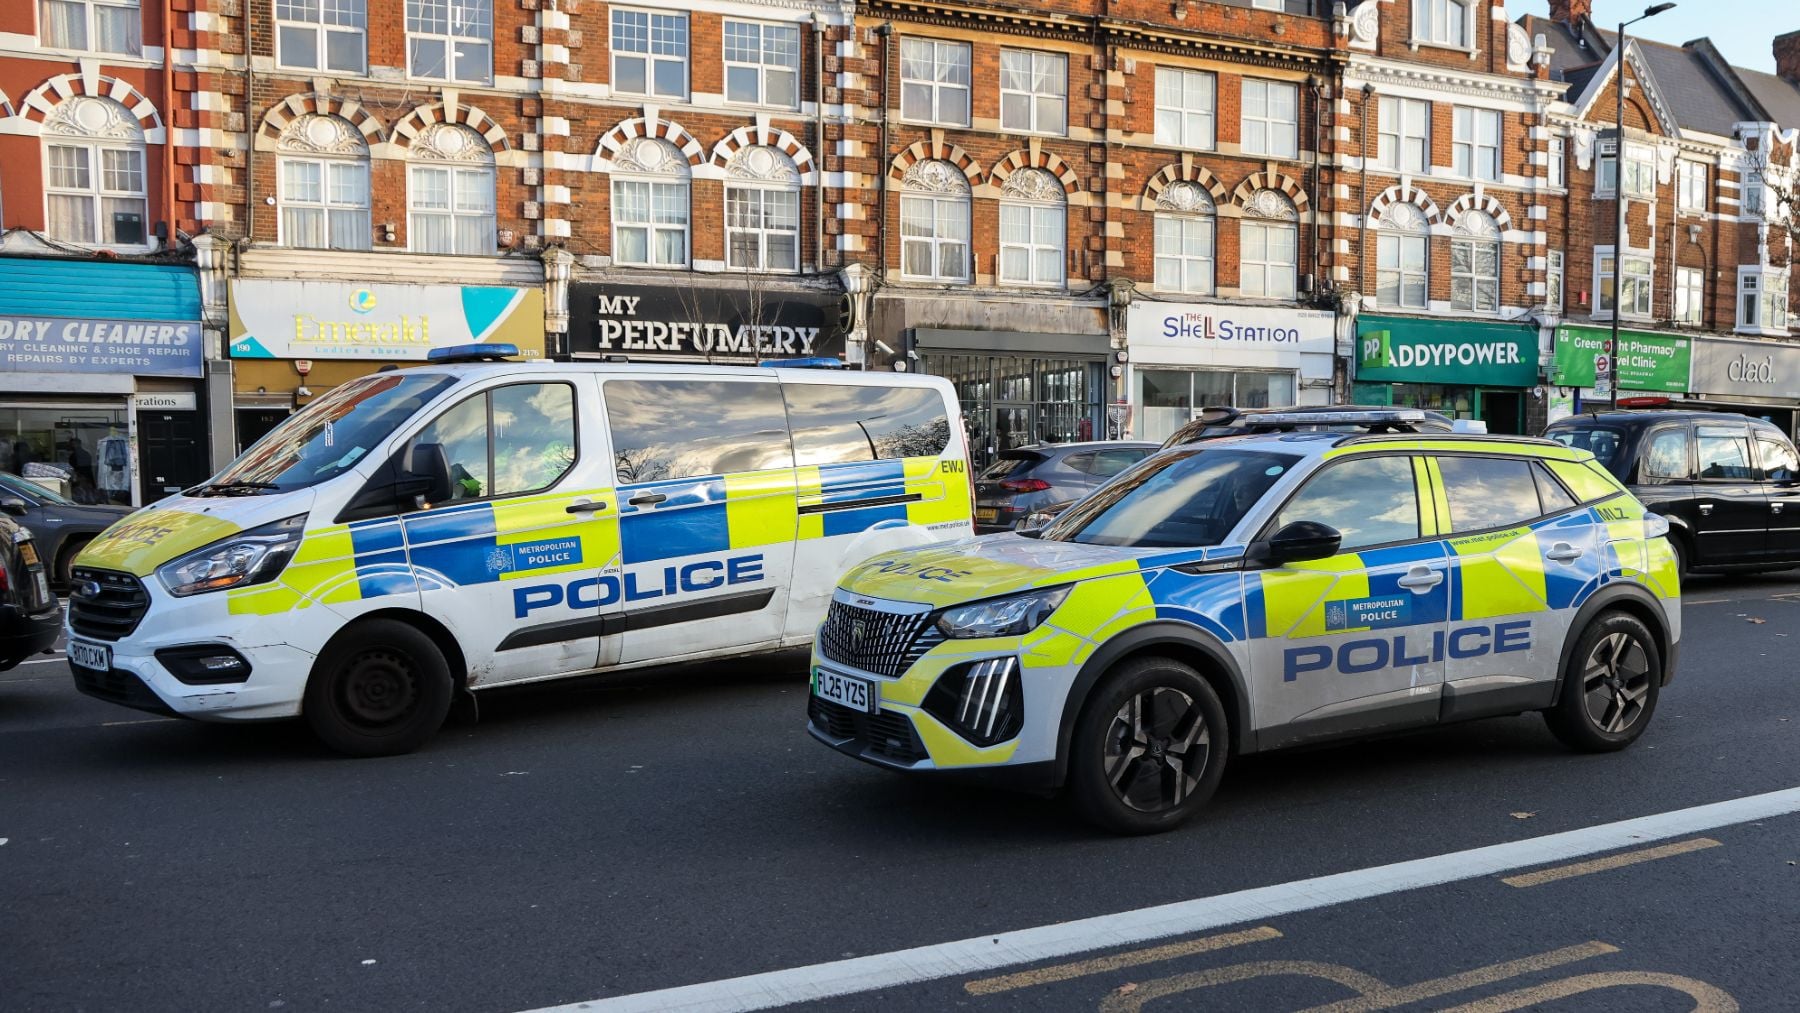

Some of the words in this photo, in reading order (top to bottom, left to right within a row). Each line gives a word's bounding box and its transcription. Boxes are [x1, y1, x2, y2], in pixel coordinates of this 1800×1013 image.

[598, 295, 640, 316] MY
[1185, 312, 1201, 322] THE
[0, 319, 52, 342] DRY
[62, 322, 190, 346] CLEANERS
[294, 313, 430, 344] Emerald
[598, 319, 820, 355] PERFUMERY
[23, 343, 88, 353] CLEANING
[93, 345, 101, 354] &
[108, 346, 141, 355] SHOE
[147, 347, 191, 357] REPAIR
[1630, 341, 1676, 358] Pharmacy
[7, 353, 63, 363] REPAIRS
[69, 356, 86, 364] BY
[91, 356, 151, 366] EXPERTS
[1631, 356, 1657, 368] Clinic
[941, 460, 964, 473] EWJ
[1595, 507, 1630, 522] MLZ
[518, 540, 577, 555] METROPOLITAN
[528, 552, 570, 565] POLICE
[512, 553, 765, 619] POLICE
[1352, 599, 1404, 611] METROPOLITAN
[1360, 611, 1398, 622] POLICE
[1283, 620, 1532, 682] POLICE
[817, 671, 842, 699] FL25
[844, 679, 866, 707] YZS
